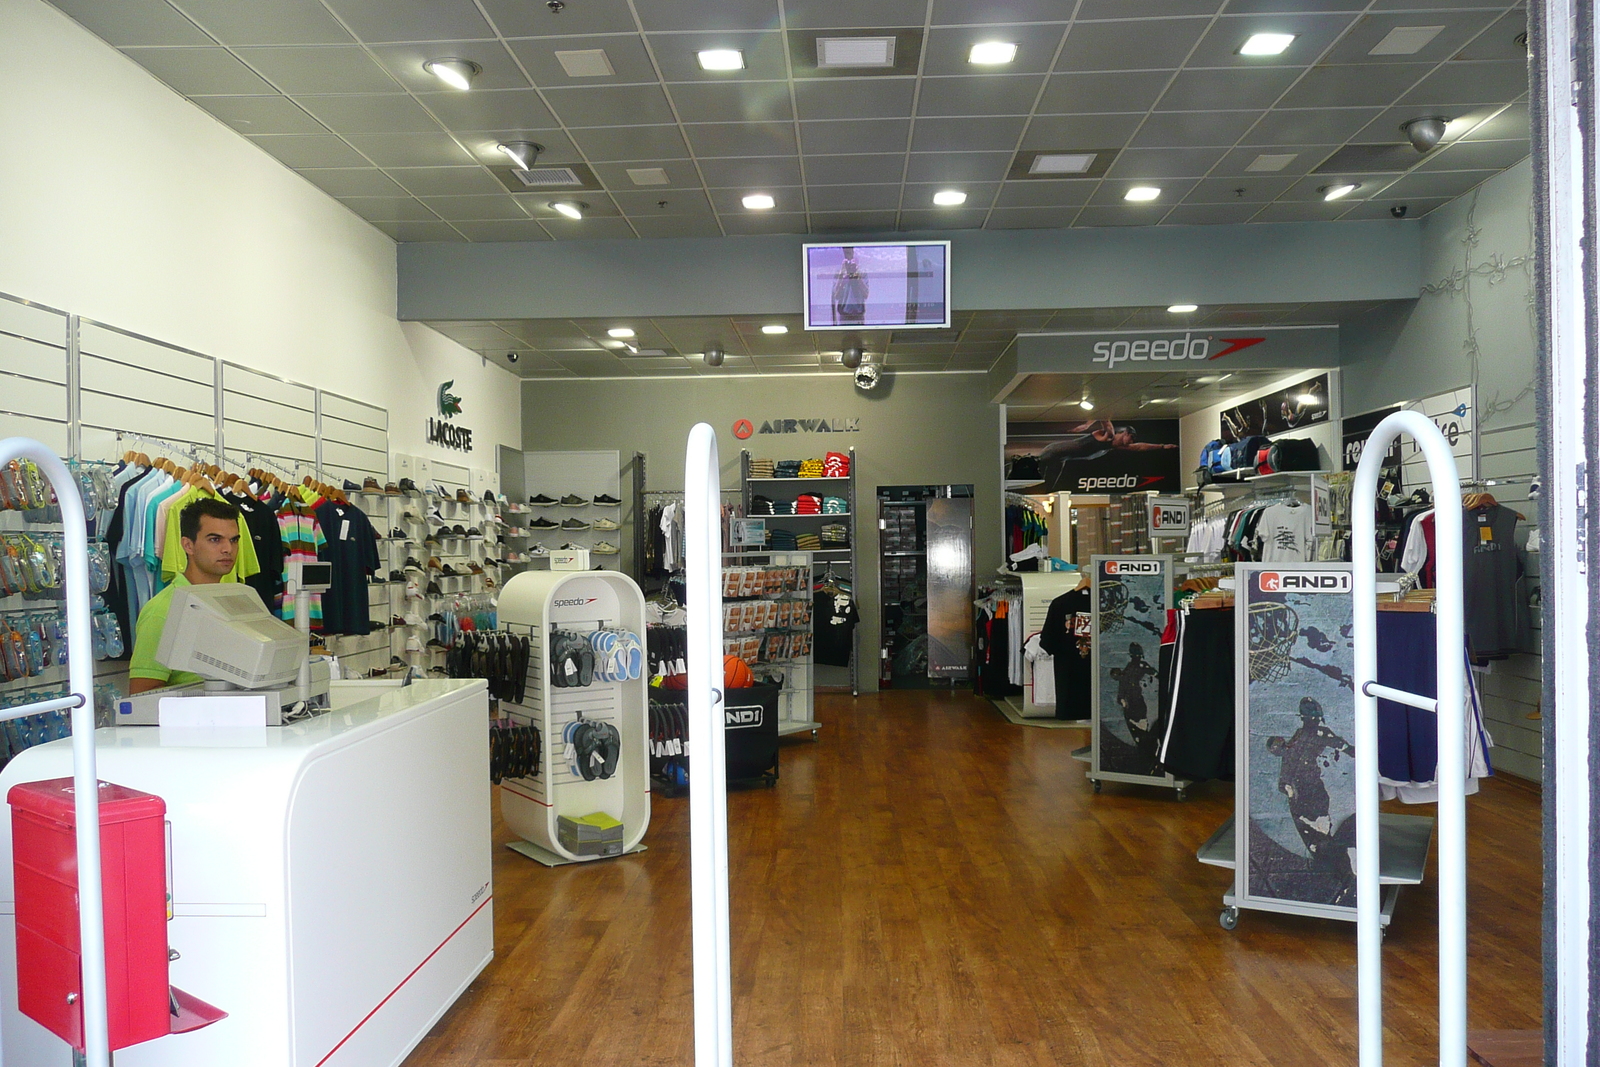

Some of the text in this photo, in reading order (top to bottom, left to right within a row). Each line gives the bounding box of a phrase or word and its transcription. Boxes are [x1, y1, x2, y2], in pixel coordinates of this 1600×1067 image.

[1092, 332, 1210, 369] speedo
[758, 418, 860, 434] AIRWALK
[429, 416, 473, 452] LACOSTE
[1077, 473, 1138, 492] speedo
[1162, 510, 1186, 525] AND1
[1119, 563, 1158, 572] AND1
[1282, 575, 1348, 589] AND1
[553, 597, 585, 608] speedo
[725, 710, 760, 724] ND1
